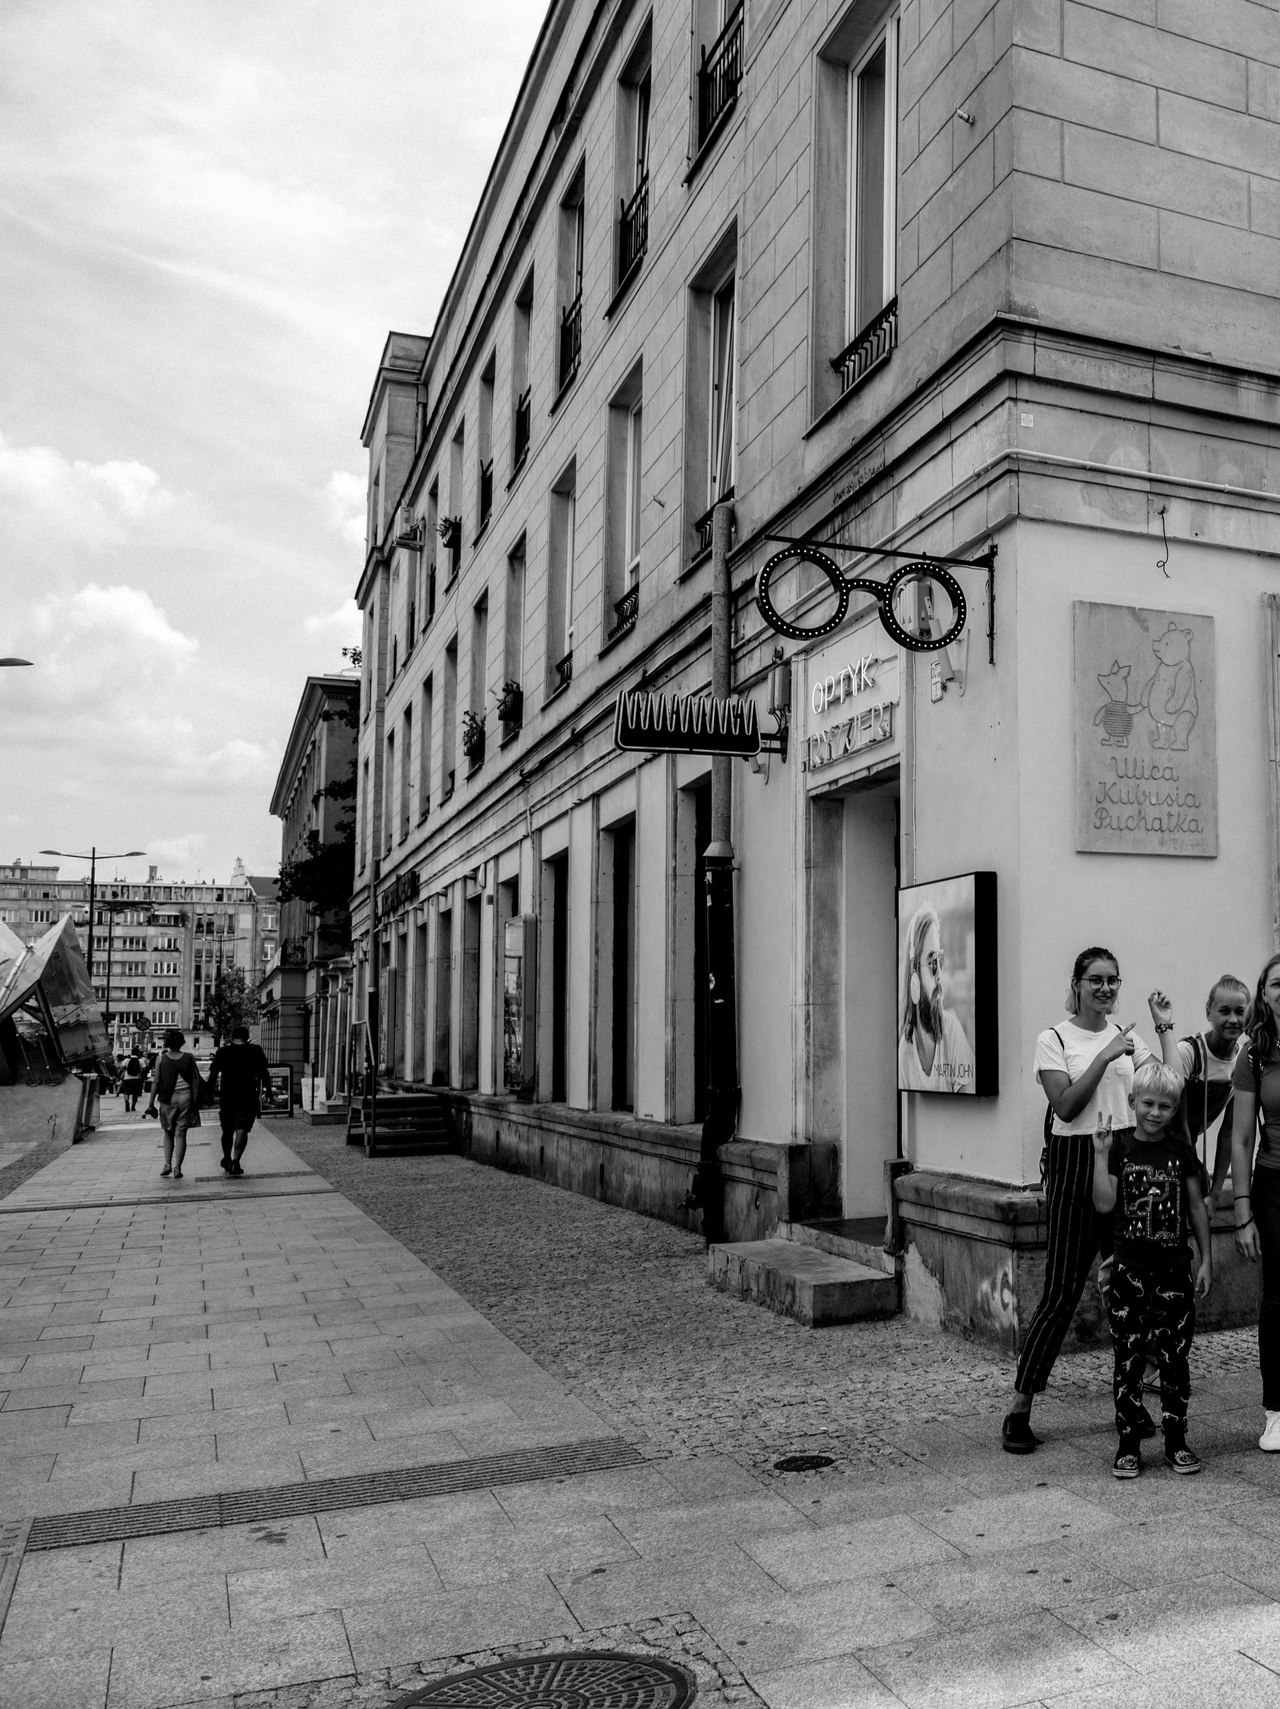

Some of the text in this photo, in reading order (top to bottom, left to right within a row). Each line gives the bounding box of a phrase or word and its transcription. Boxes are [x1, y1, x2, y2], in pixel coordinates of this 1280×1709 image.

[812, 653, 874, 714] OPTYK
[1110, 756, 1179, 782] Ulica
[1096, 781, 1201, 808] Kubusia
[1094, 806, 1204, 834] Puchatka
[933, 1063, 974, 1078] MARTIN JOHN
